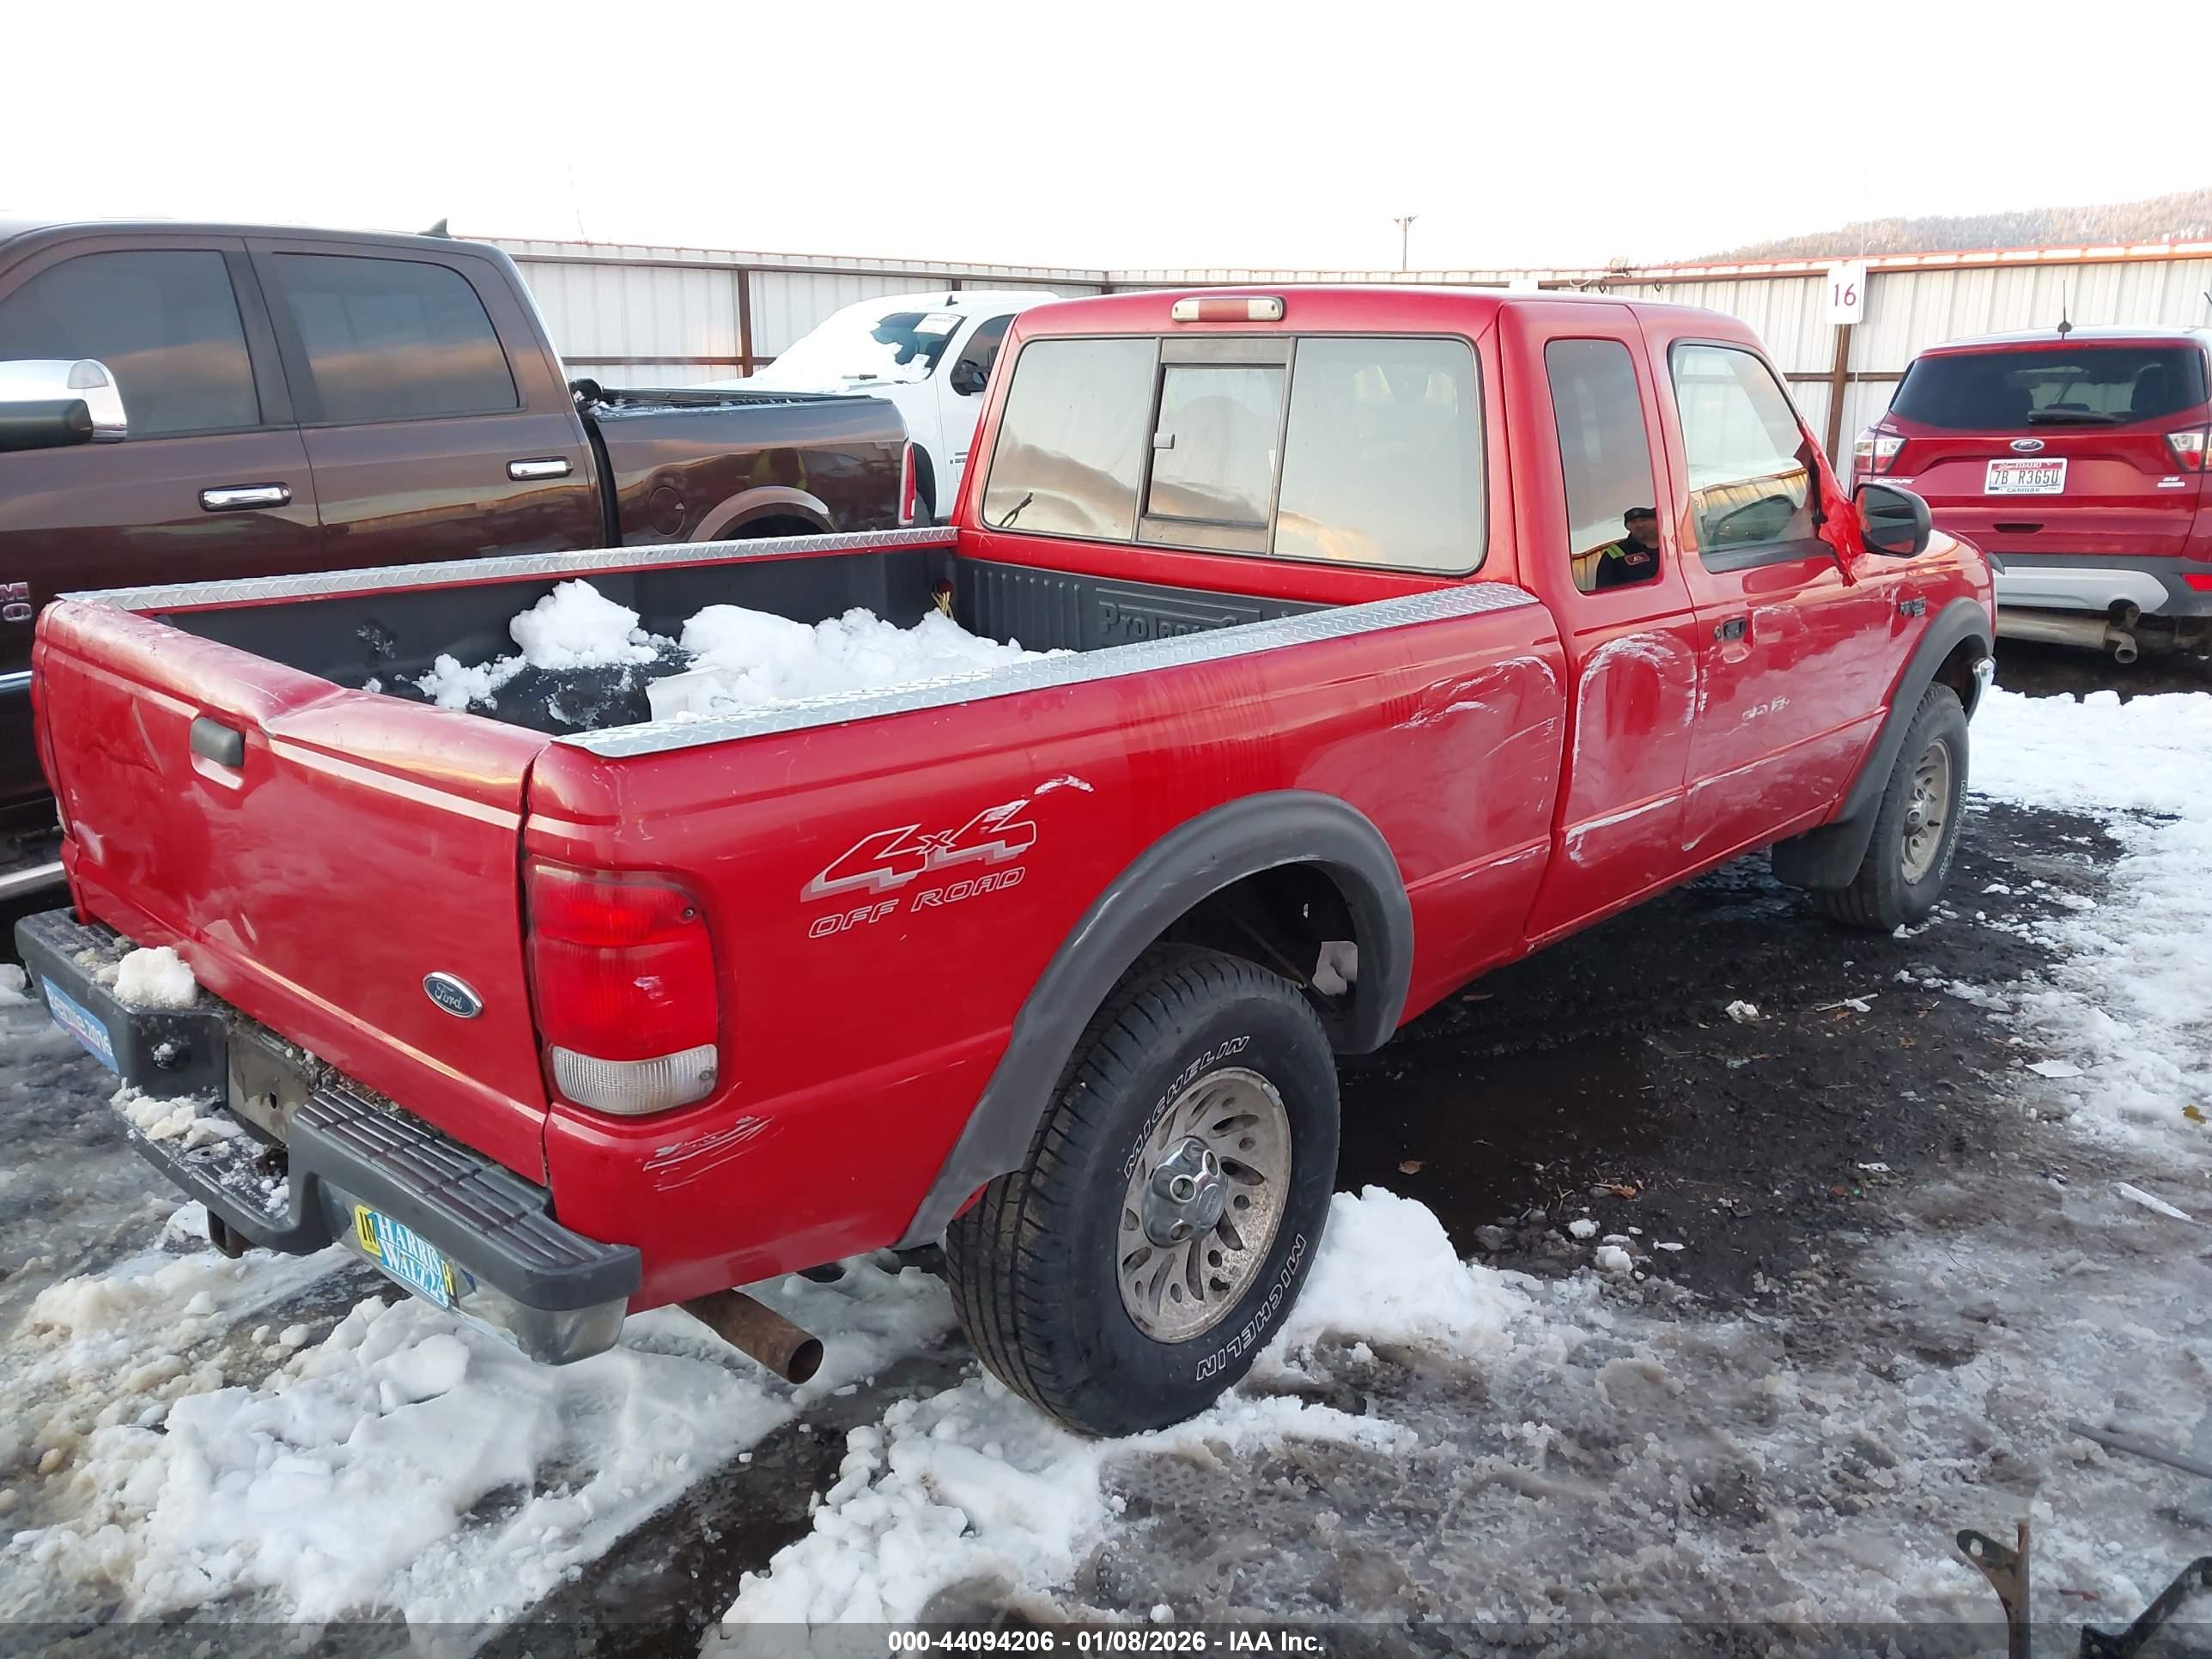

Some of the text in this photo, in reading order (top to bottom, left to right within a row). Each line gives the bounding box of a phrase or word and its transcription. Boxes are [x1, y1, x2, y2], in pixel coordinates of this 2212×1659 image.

[1834, 283, 1856, 307] 16
[1994, 469, 2059, 485] 7B R365U
[808, 866, 1026, 939] OFF ROAD
[1123, 1035, 1251, 1180] MICHELIN
[374, 1212, 442, 1277] HARRIS
[1195, 1233, 1307, 1381] MICHELIN
